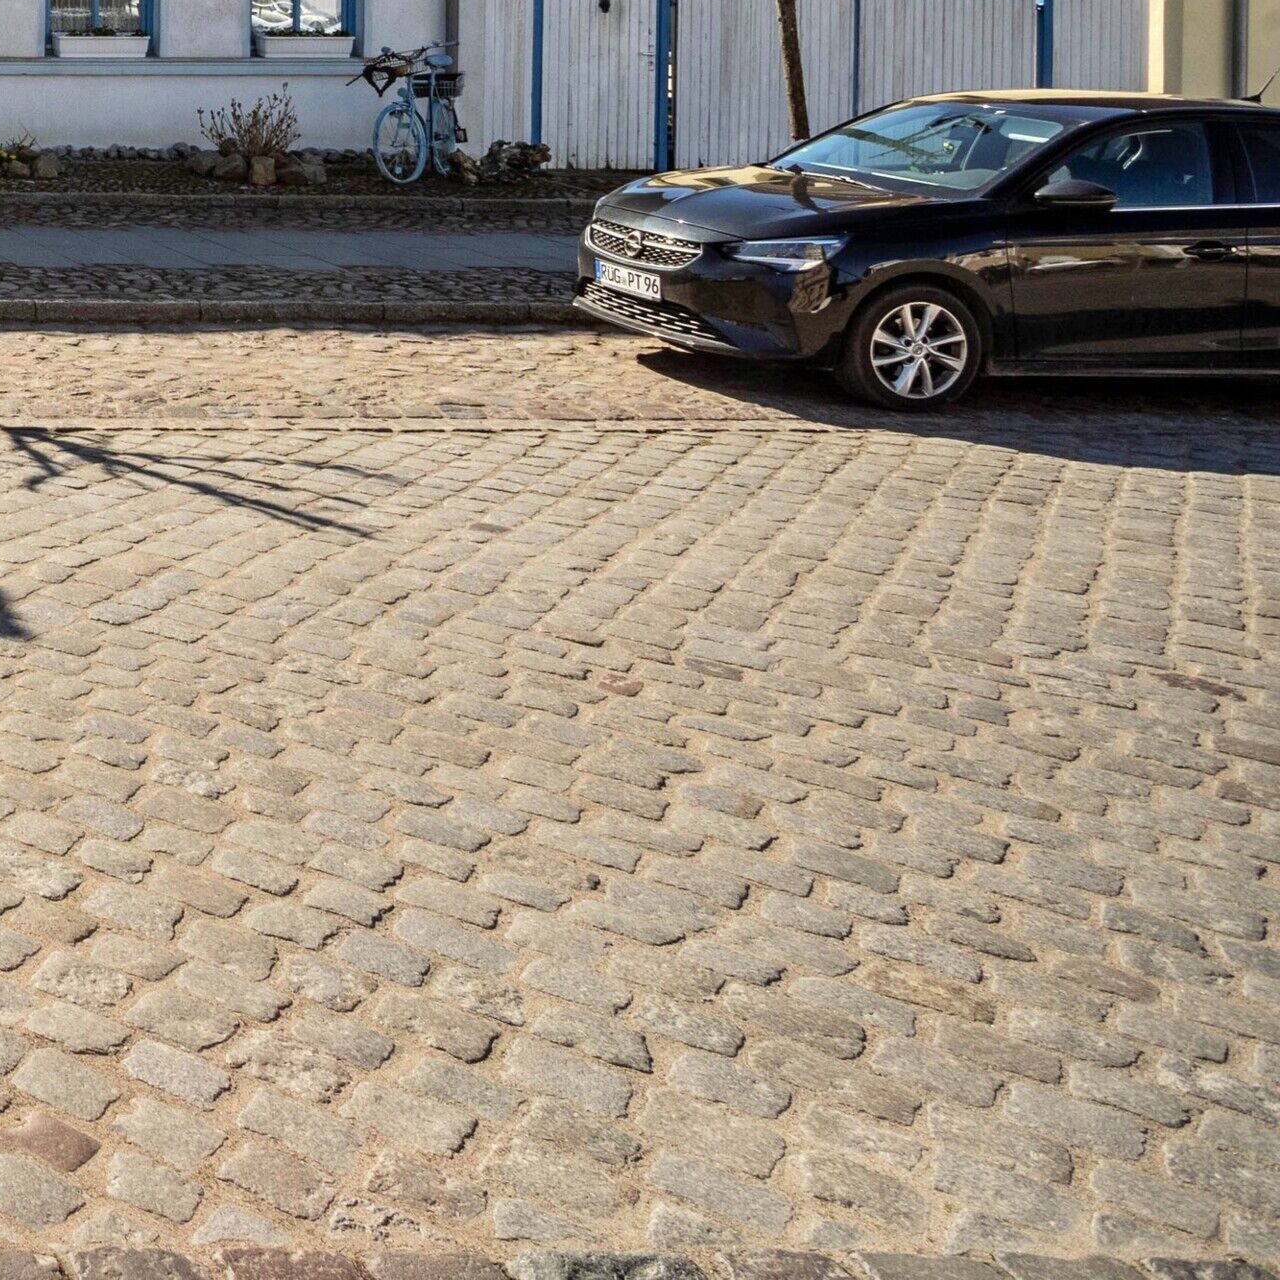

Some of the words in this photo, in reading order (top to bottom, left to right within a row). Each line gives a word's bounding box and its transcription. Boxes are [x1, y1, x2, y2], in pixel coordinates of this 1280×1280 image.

[600, 264, 621, 284] RÜG
[627, 271, 642, 290] PT
[644, 276, 659, 295] 96
